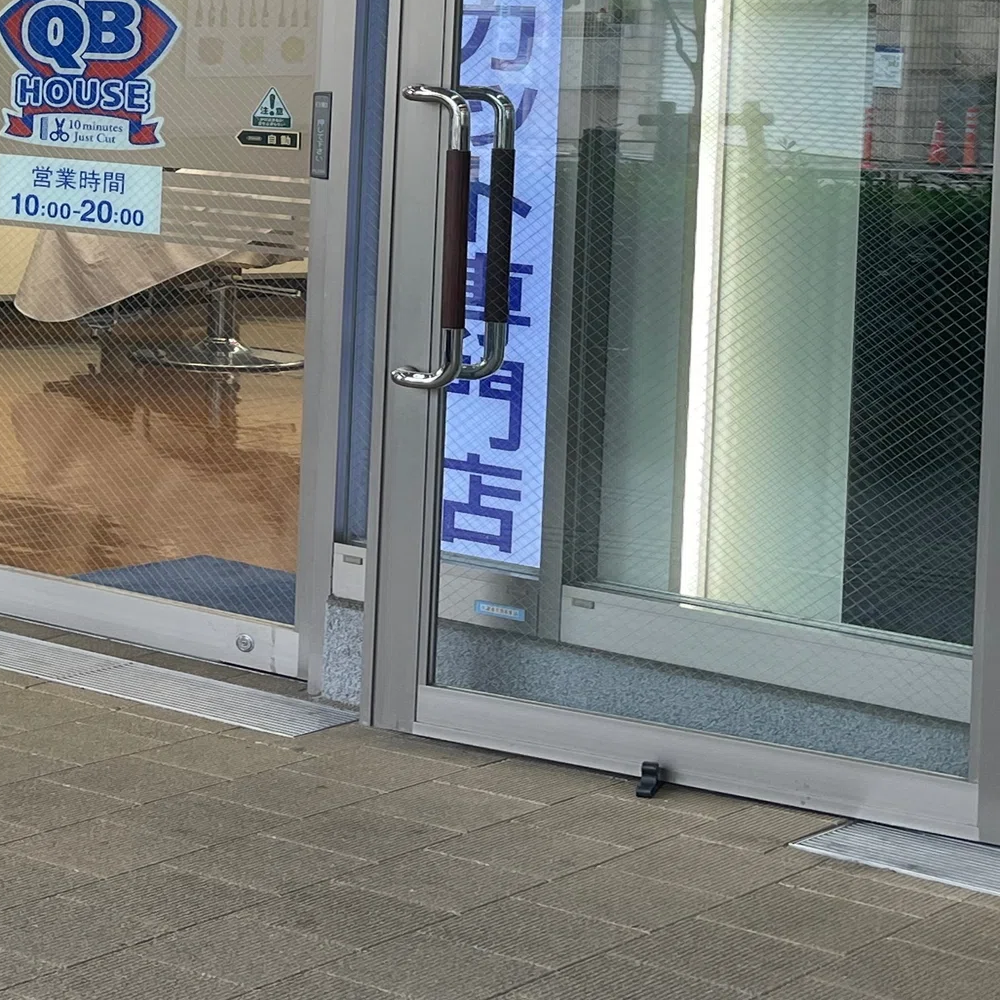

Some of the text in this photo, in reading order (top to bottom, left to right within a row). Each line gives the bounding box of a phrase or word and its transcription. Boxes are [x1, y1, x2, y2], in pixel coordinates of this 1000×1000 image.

[15, 75, 151, 113] HOUSE
[68, 118, 124, 133] 10 minutes
[73, 132, 116, 144] Just Cut
[267, 135, 291, 146] 自動
[32, 165, 125, 195] 営業時間
[11, 193, 144, 227] 10:00-20:00
